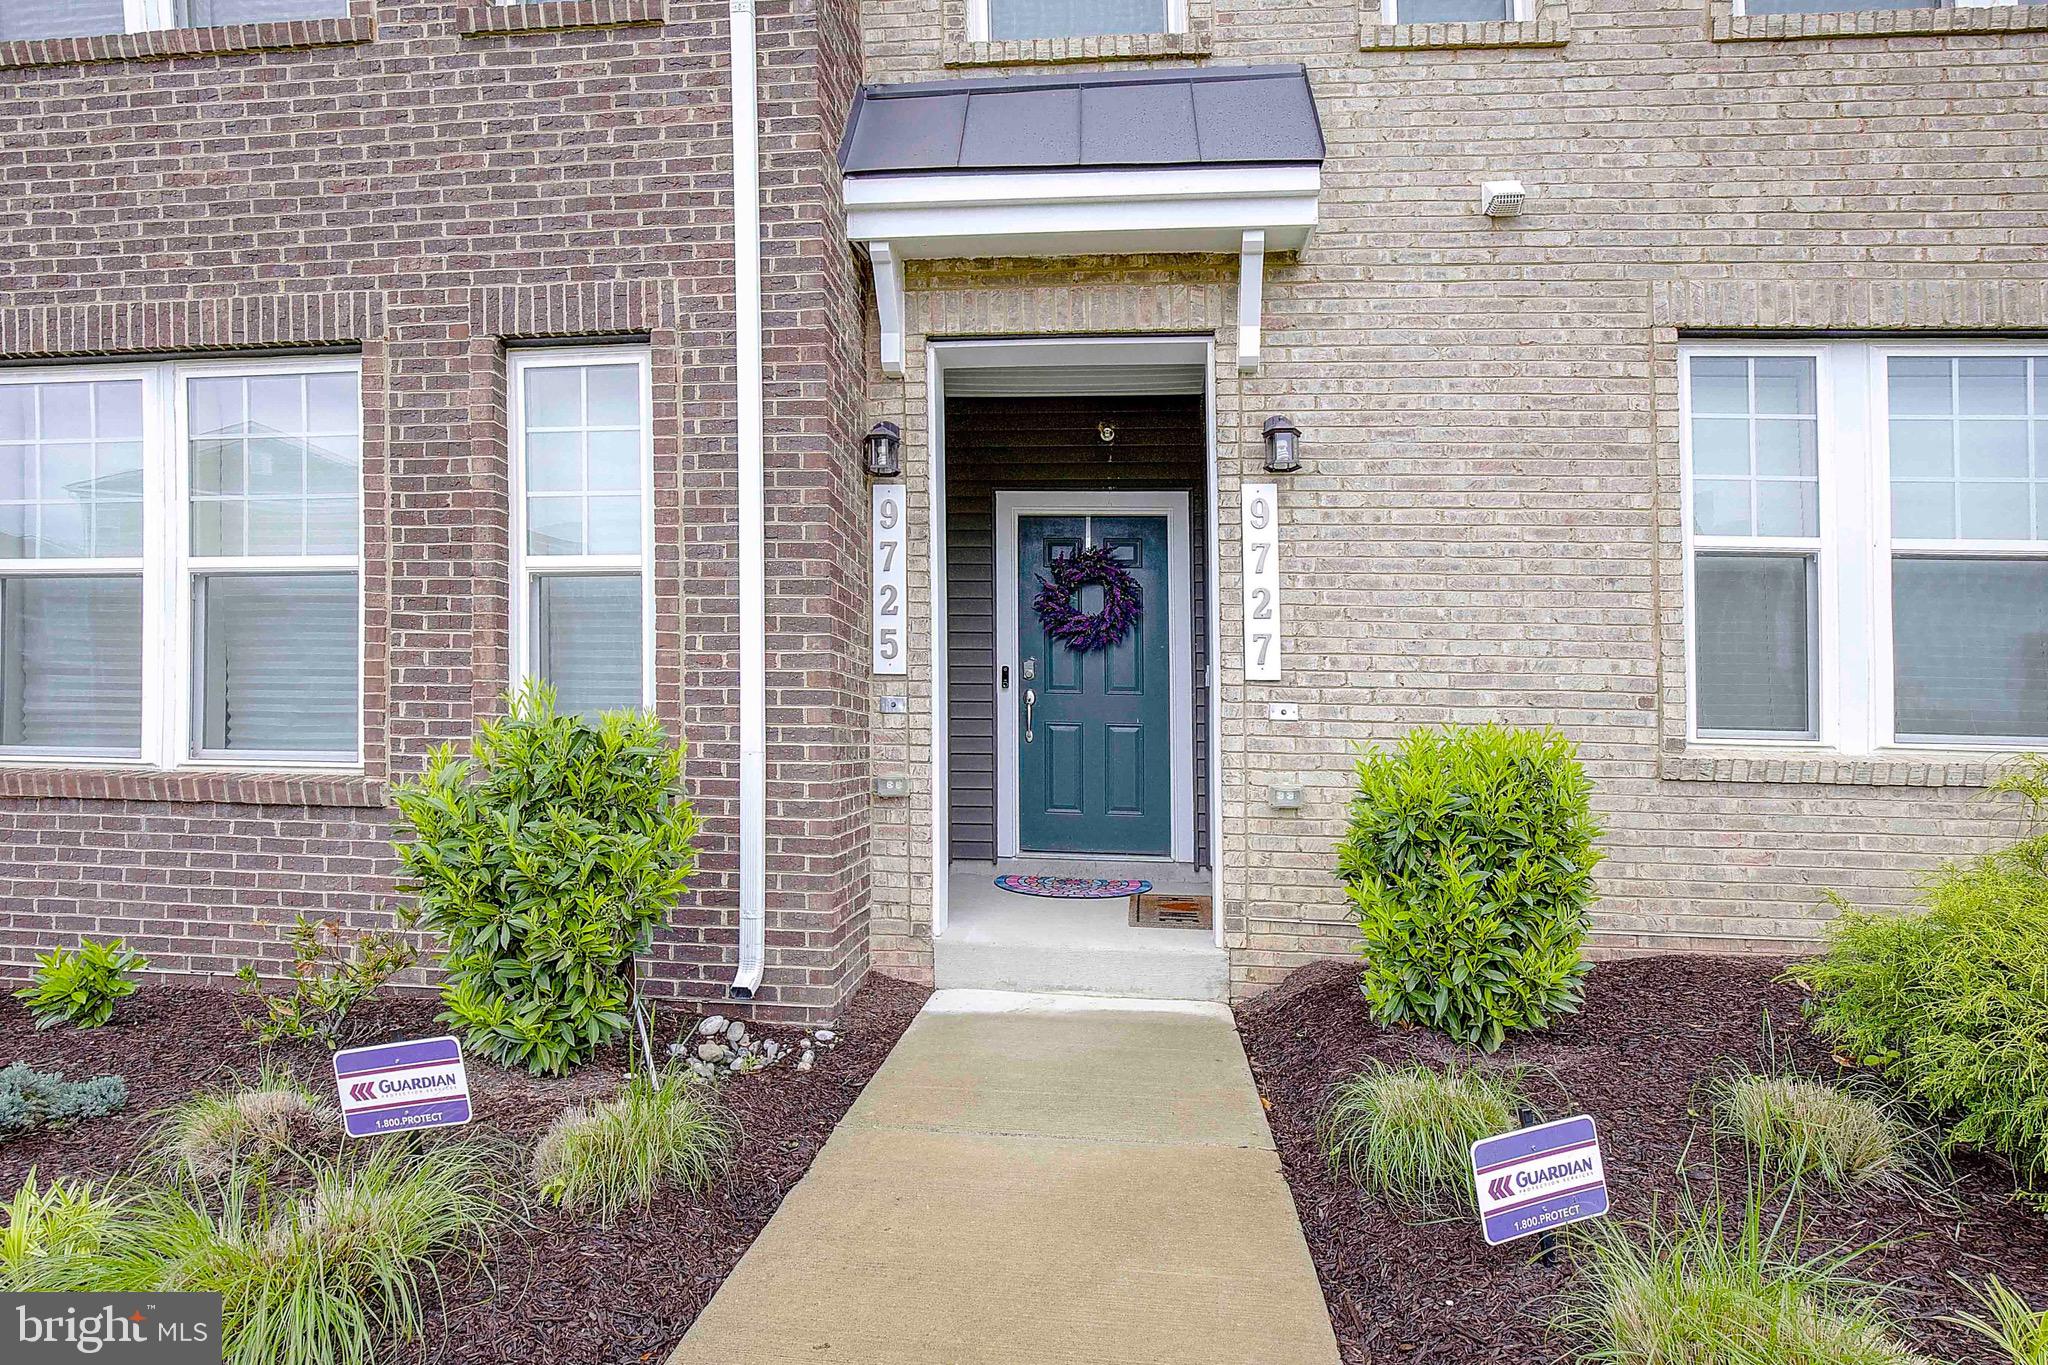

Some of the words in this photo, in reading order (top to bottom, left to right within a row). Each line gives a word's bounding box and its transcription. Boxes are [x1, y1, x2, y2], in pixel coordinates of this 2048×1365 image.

[879, 498, 899, 660] 9725
[1250, 497, 1272, 666] 9727
[379, 1073, 457, 1094] GUARDIAN
[375, 1112, 443, 1129] 1.800.PROTECT
[1516, 1157, 1593, 1188] GUARDIAN
[1514, 1204, 1580, 1232] 1.800.PROTECT
